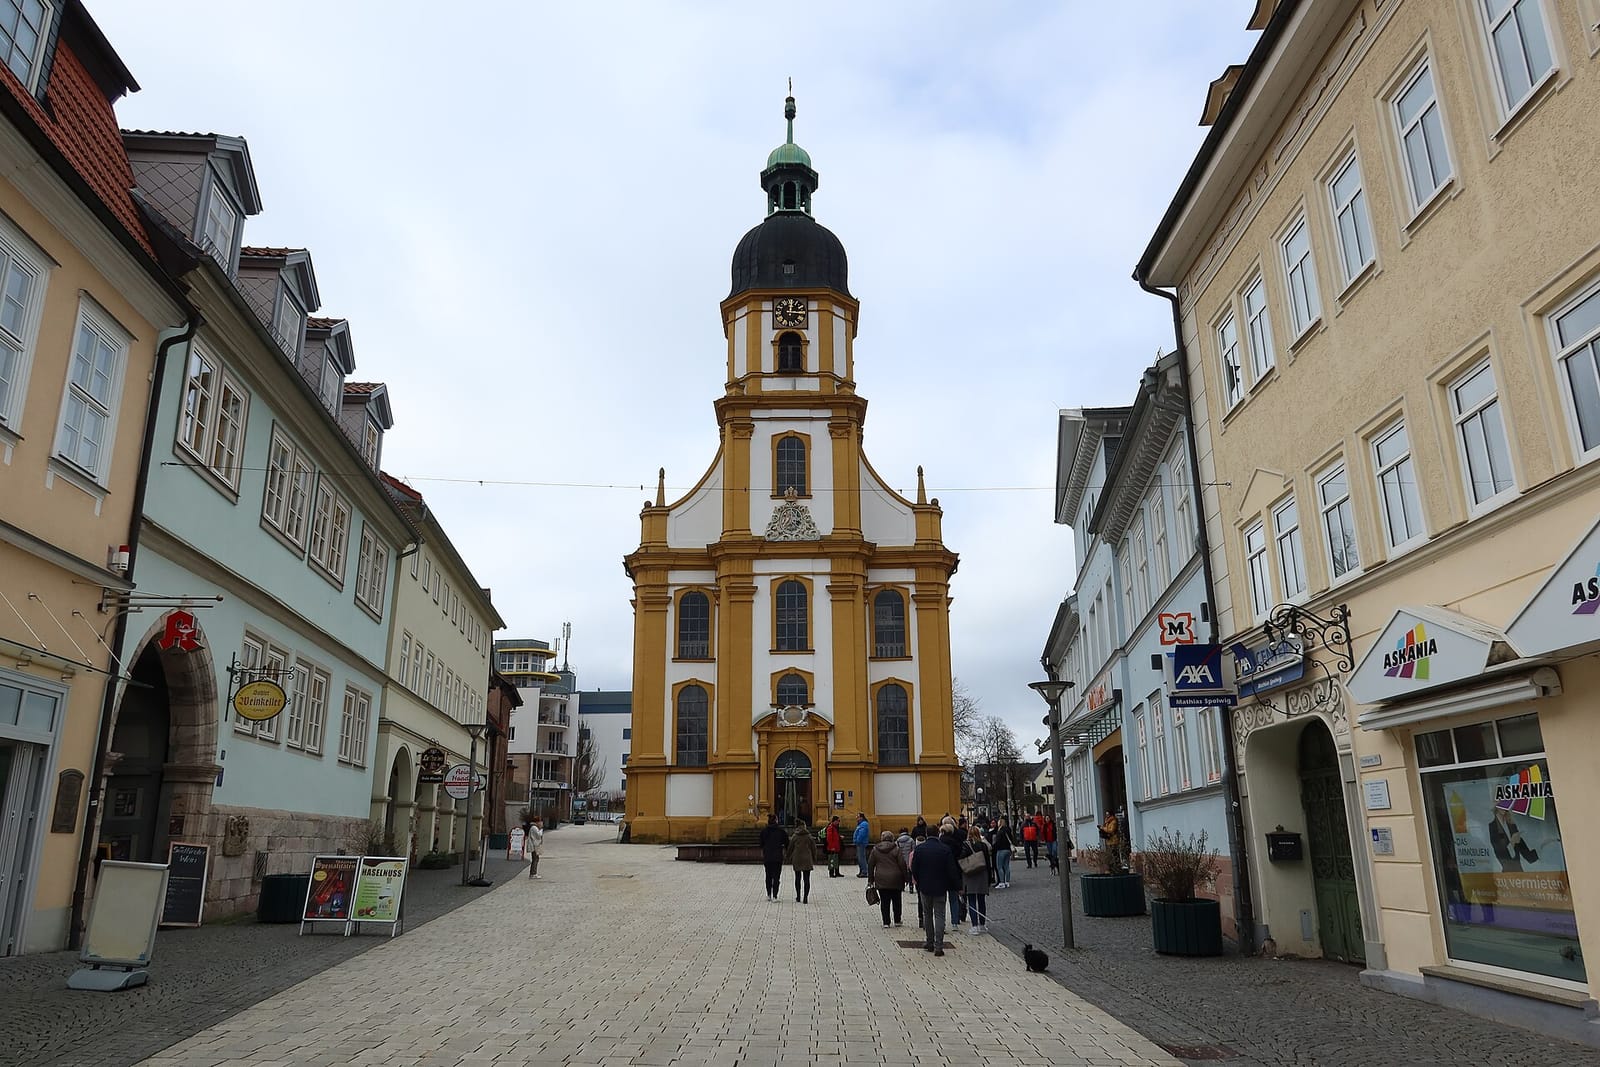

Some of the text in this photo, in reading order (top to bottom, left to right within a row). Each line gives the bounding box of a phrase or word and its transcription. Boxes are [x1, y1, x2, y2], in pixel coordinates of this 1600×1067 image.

[1167, 621, 1186, 636] M
[1384, 638, 1438, 669] ASKANIA
[1175, 665, 1215, 684] AXA
[238, 696, 282, 707] Weinkeller
[1175, 697, 1203, 706] Mathias
[1496, 782, 1554, 800] ASKANIA
[361, 868, 402, 878] HASELNUSS
[1509, 875, 1565, 890] vermieten
